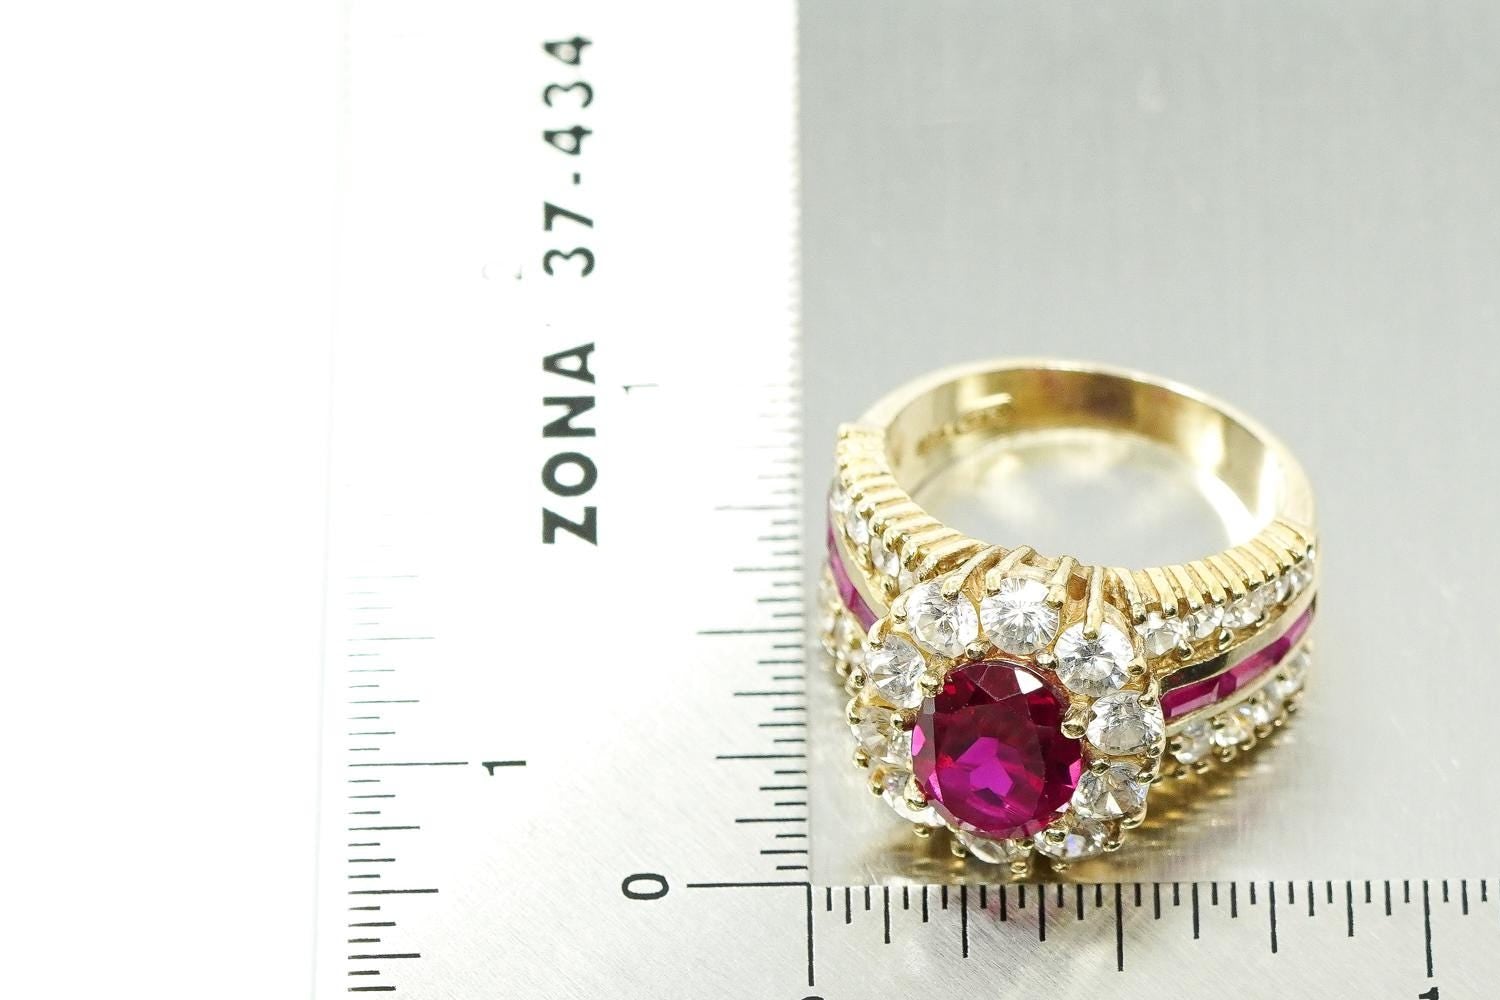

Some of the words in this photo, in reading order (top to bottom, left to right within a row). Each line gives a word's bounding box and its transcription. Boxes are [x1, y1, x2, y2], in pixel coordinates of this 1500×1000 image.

[541, 35, 595, 277] 37-434
[541, 342, 598, 547] ZONA
[481, 759, 527, 776] 1
[621, 873, 670, 901] 0
